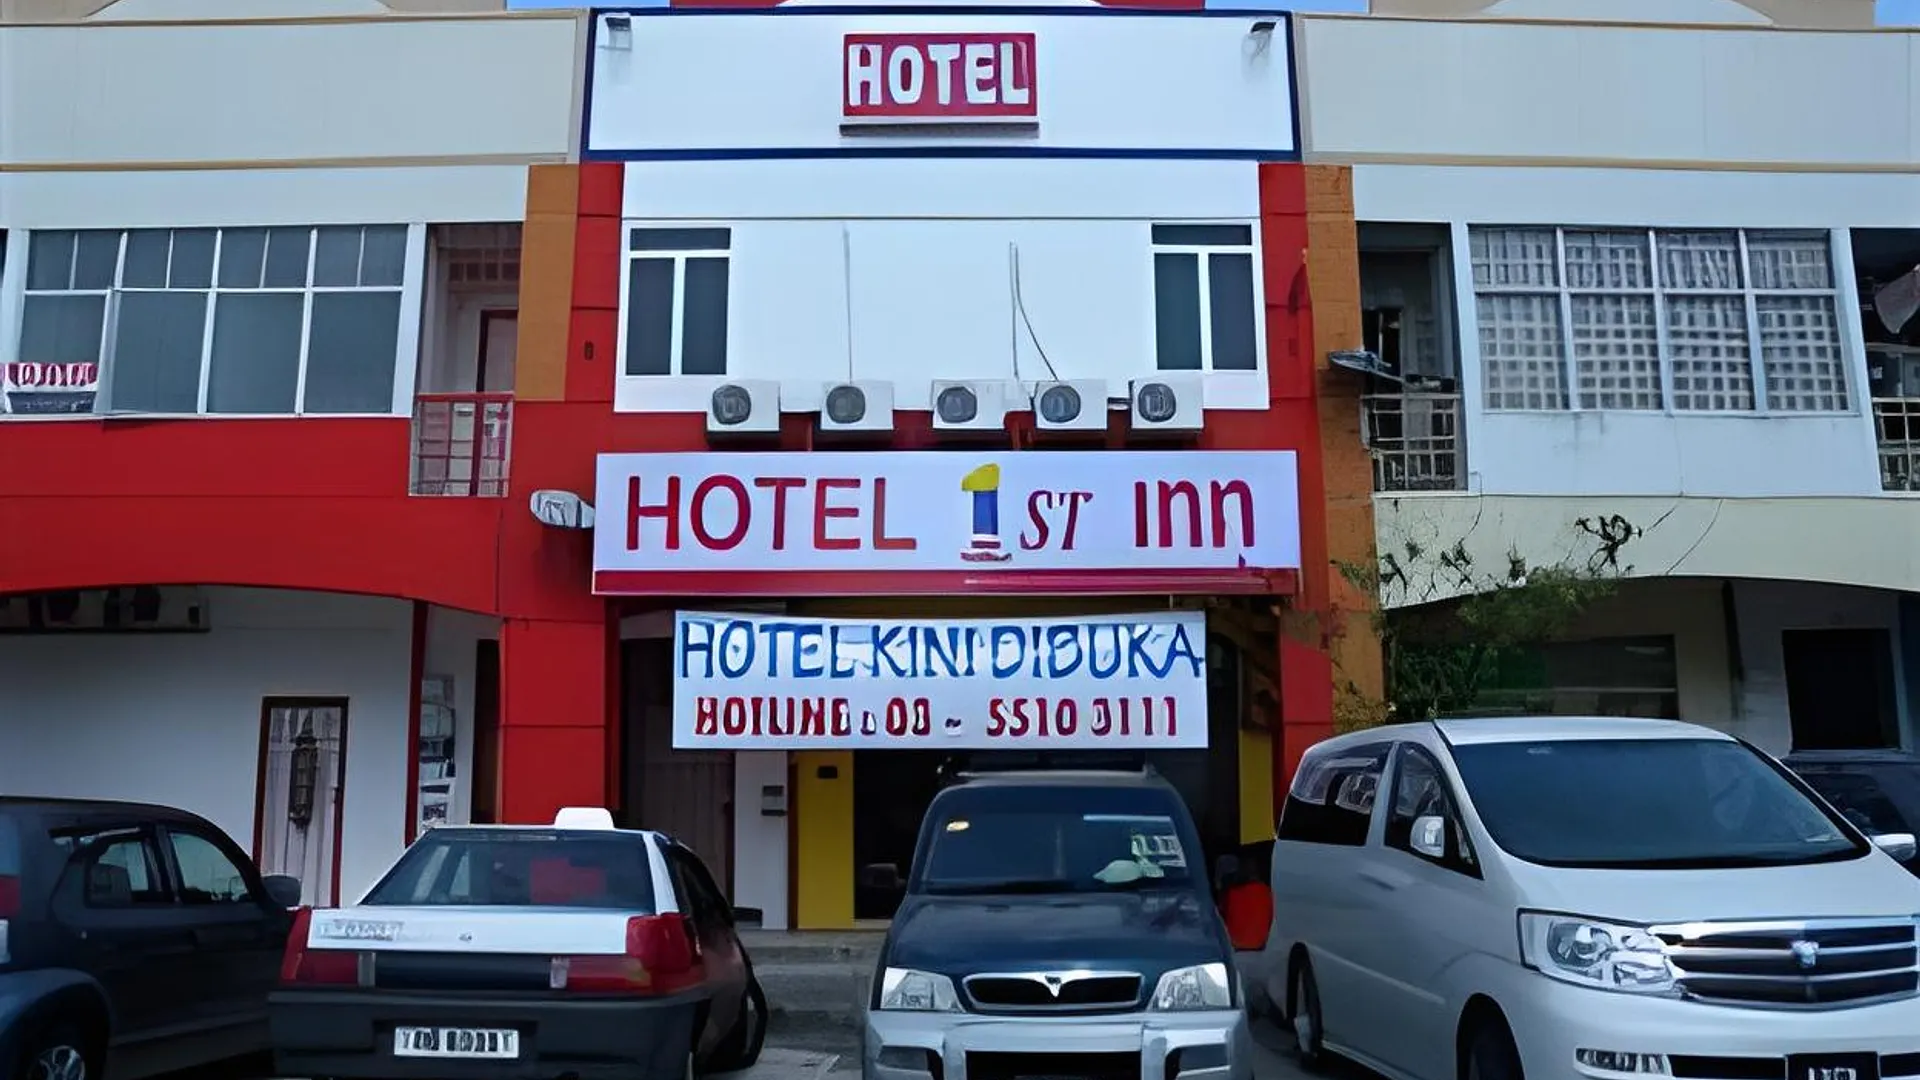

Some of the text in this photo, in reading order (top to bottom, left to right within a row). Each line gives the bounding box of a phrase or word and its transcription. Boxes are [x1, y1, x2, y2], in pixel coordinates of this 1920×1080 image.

[848, 42, 1029, 106] HOTEL
[626, 474, 917, 551] HOTEL
[681, 620, 855, 679] HOTEL
